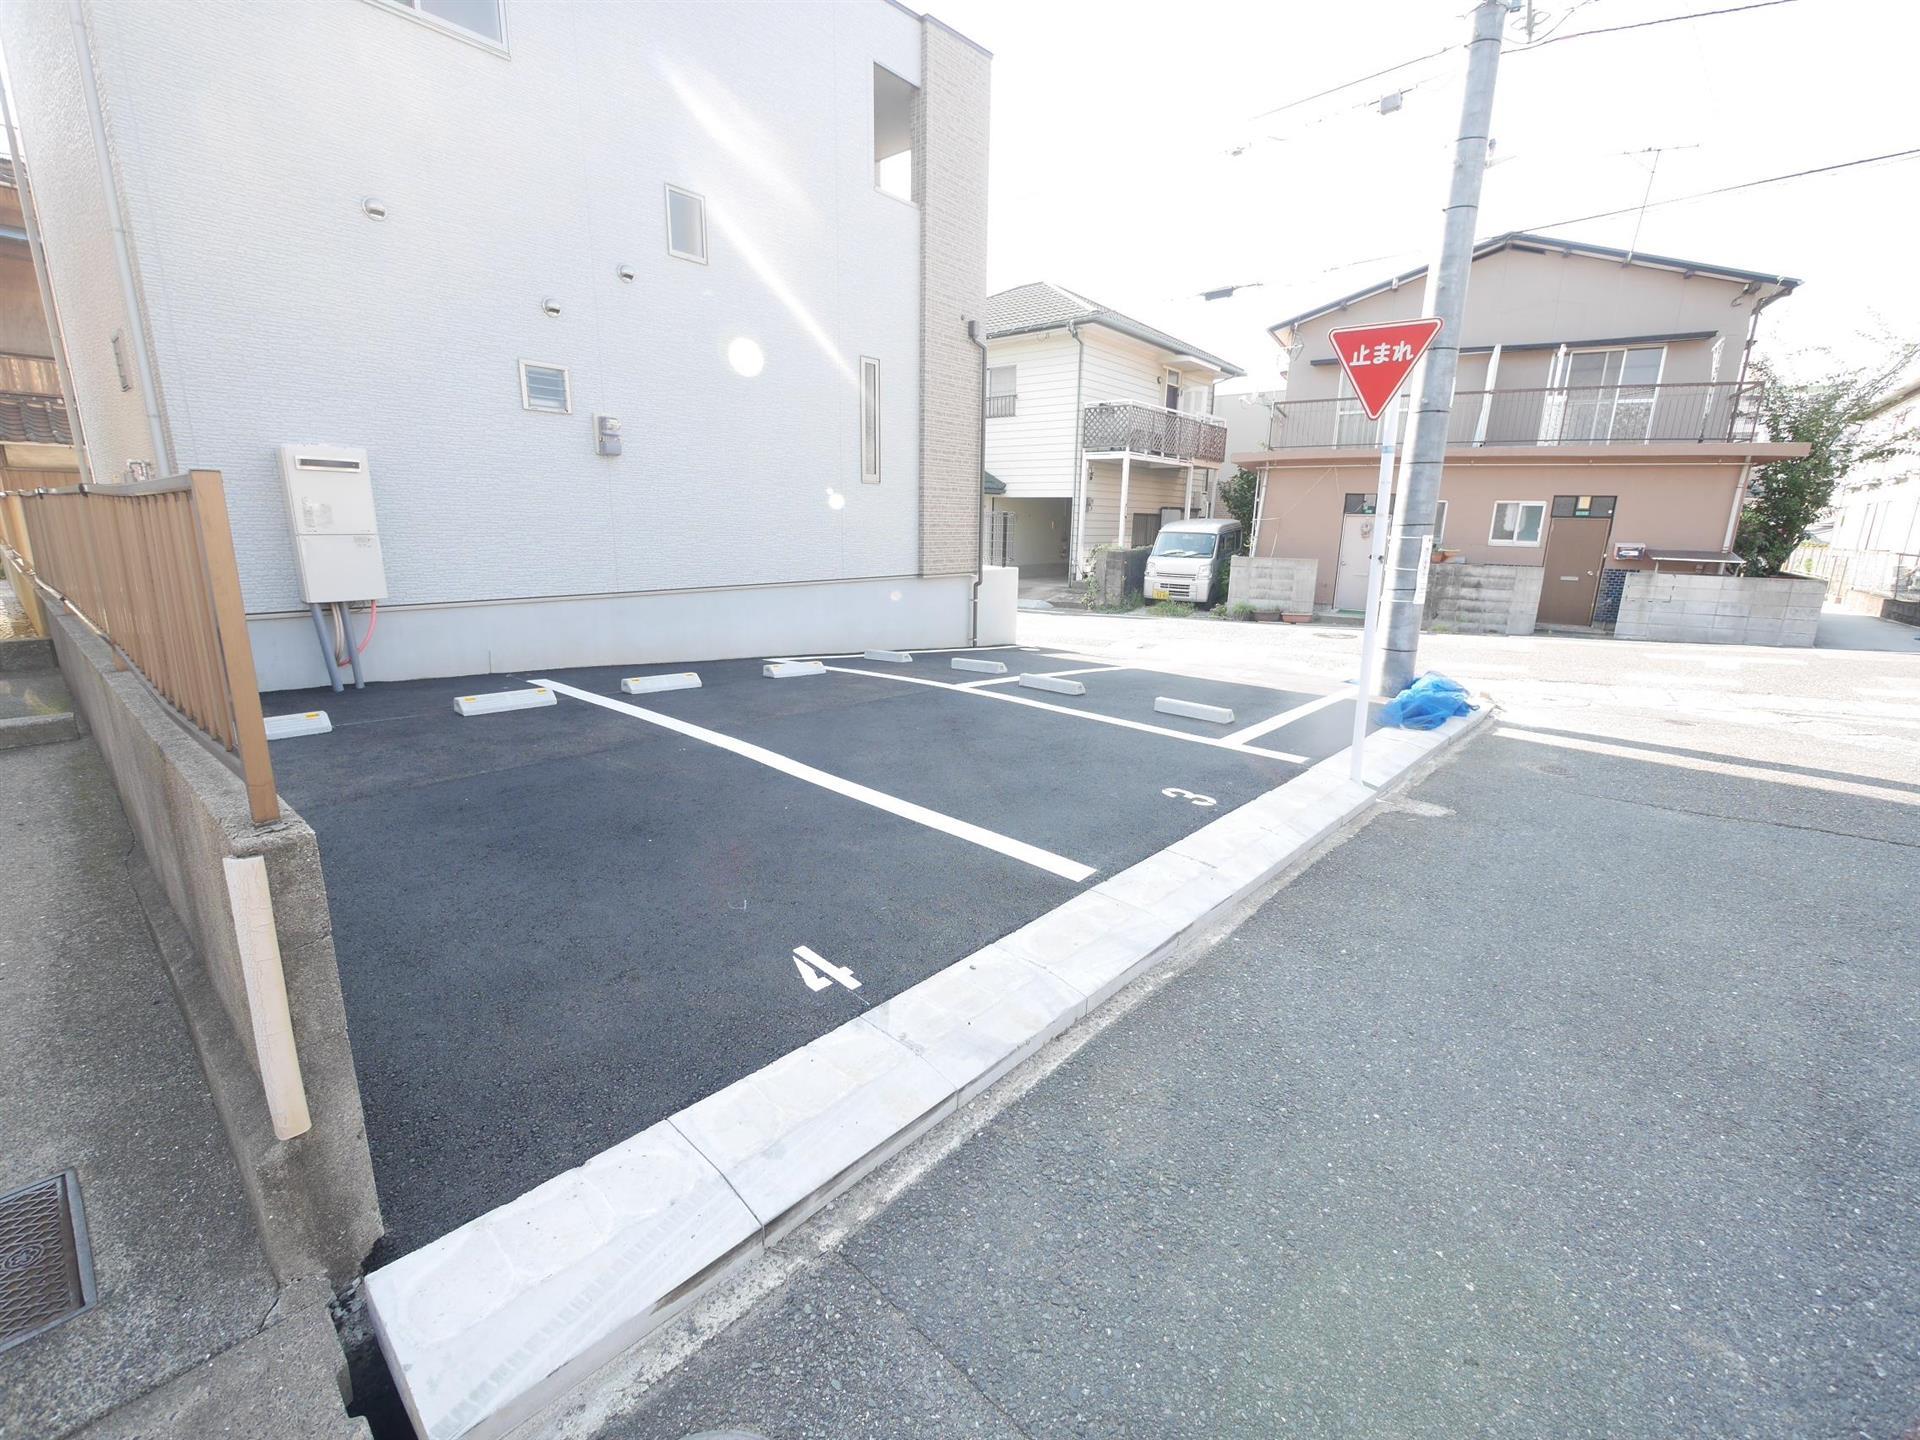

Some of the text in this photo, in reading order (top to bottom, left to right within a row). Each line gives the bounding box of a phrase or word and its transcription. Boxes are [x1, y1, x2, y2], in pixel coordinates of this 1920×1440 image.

[1349, 340, 1414, 366] 止まれ
[1161, 787, 1217, 806] 3
[792, 945, 863, 993] 4
